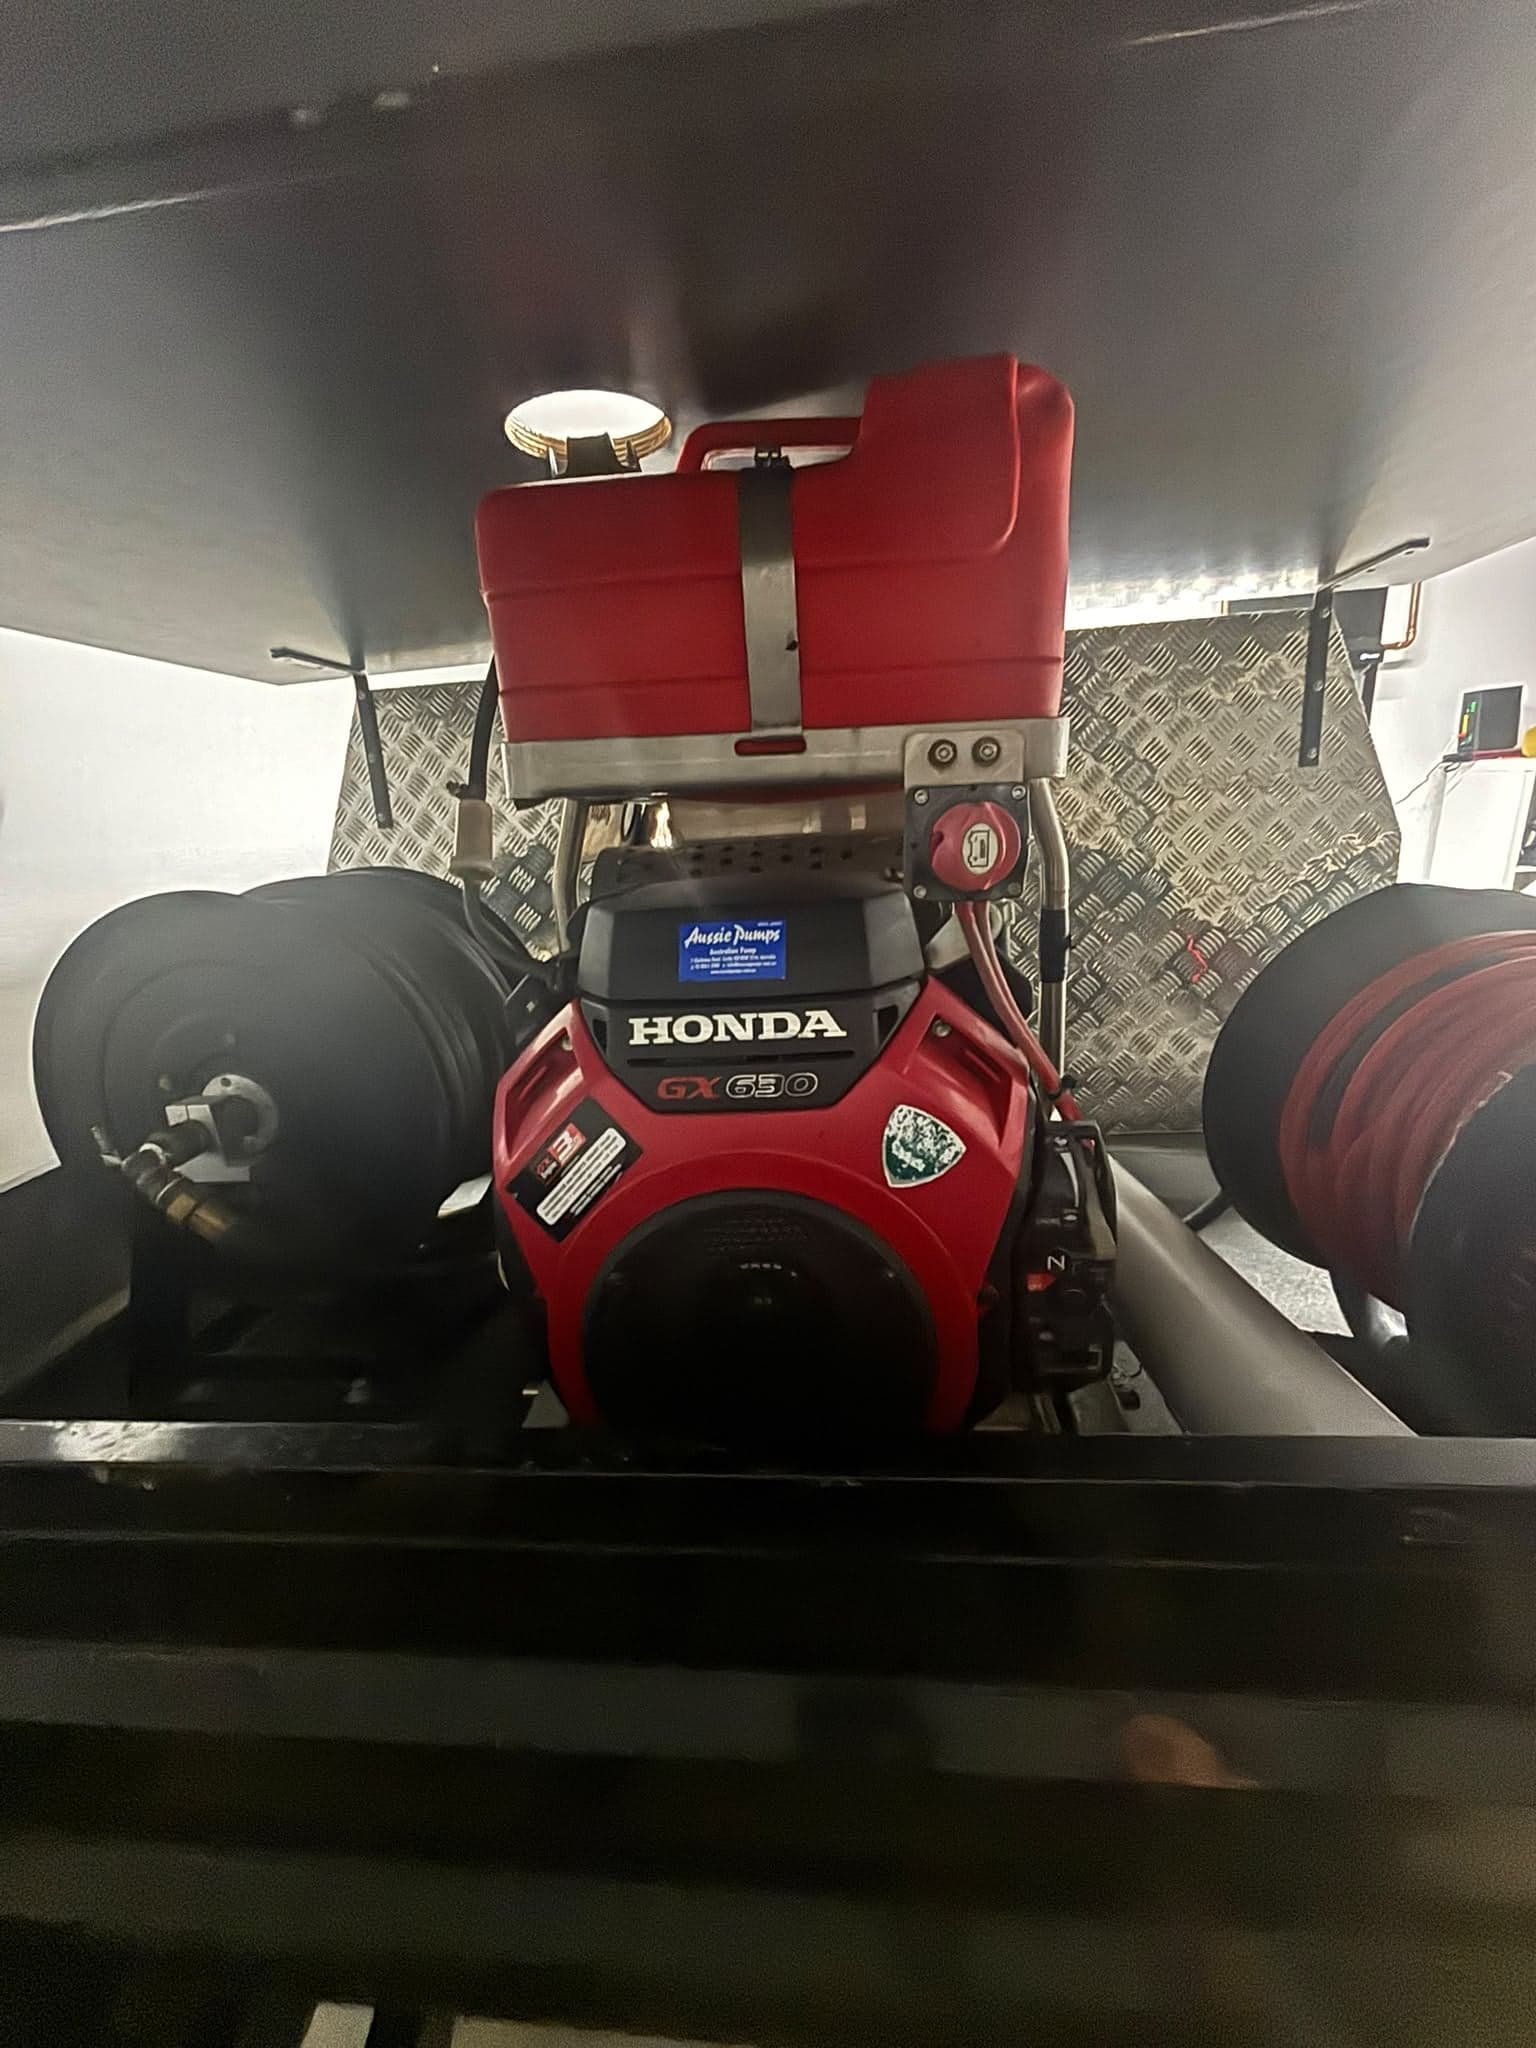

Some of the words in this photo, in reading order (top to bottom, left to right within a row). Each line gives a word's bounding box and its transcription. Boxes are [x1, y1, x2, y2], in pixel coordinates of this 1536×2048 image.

[684, 926, 732, 948] Aussie
[733, 924, 780, 946] Pumps
[628, 1010, 848, 1045] HONDA
[656, 1076, 722, 1100] GX
[726, 1072, 818, 1099] 630
